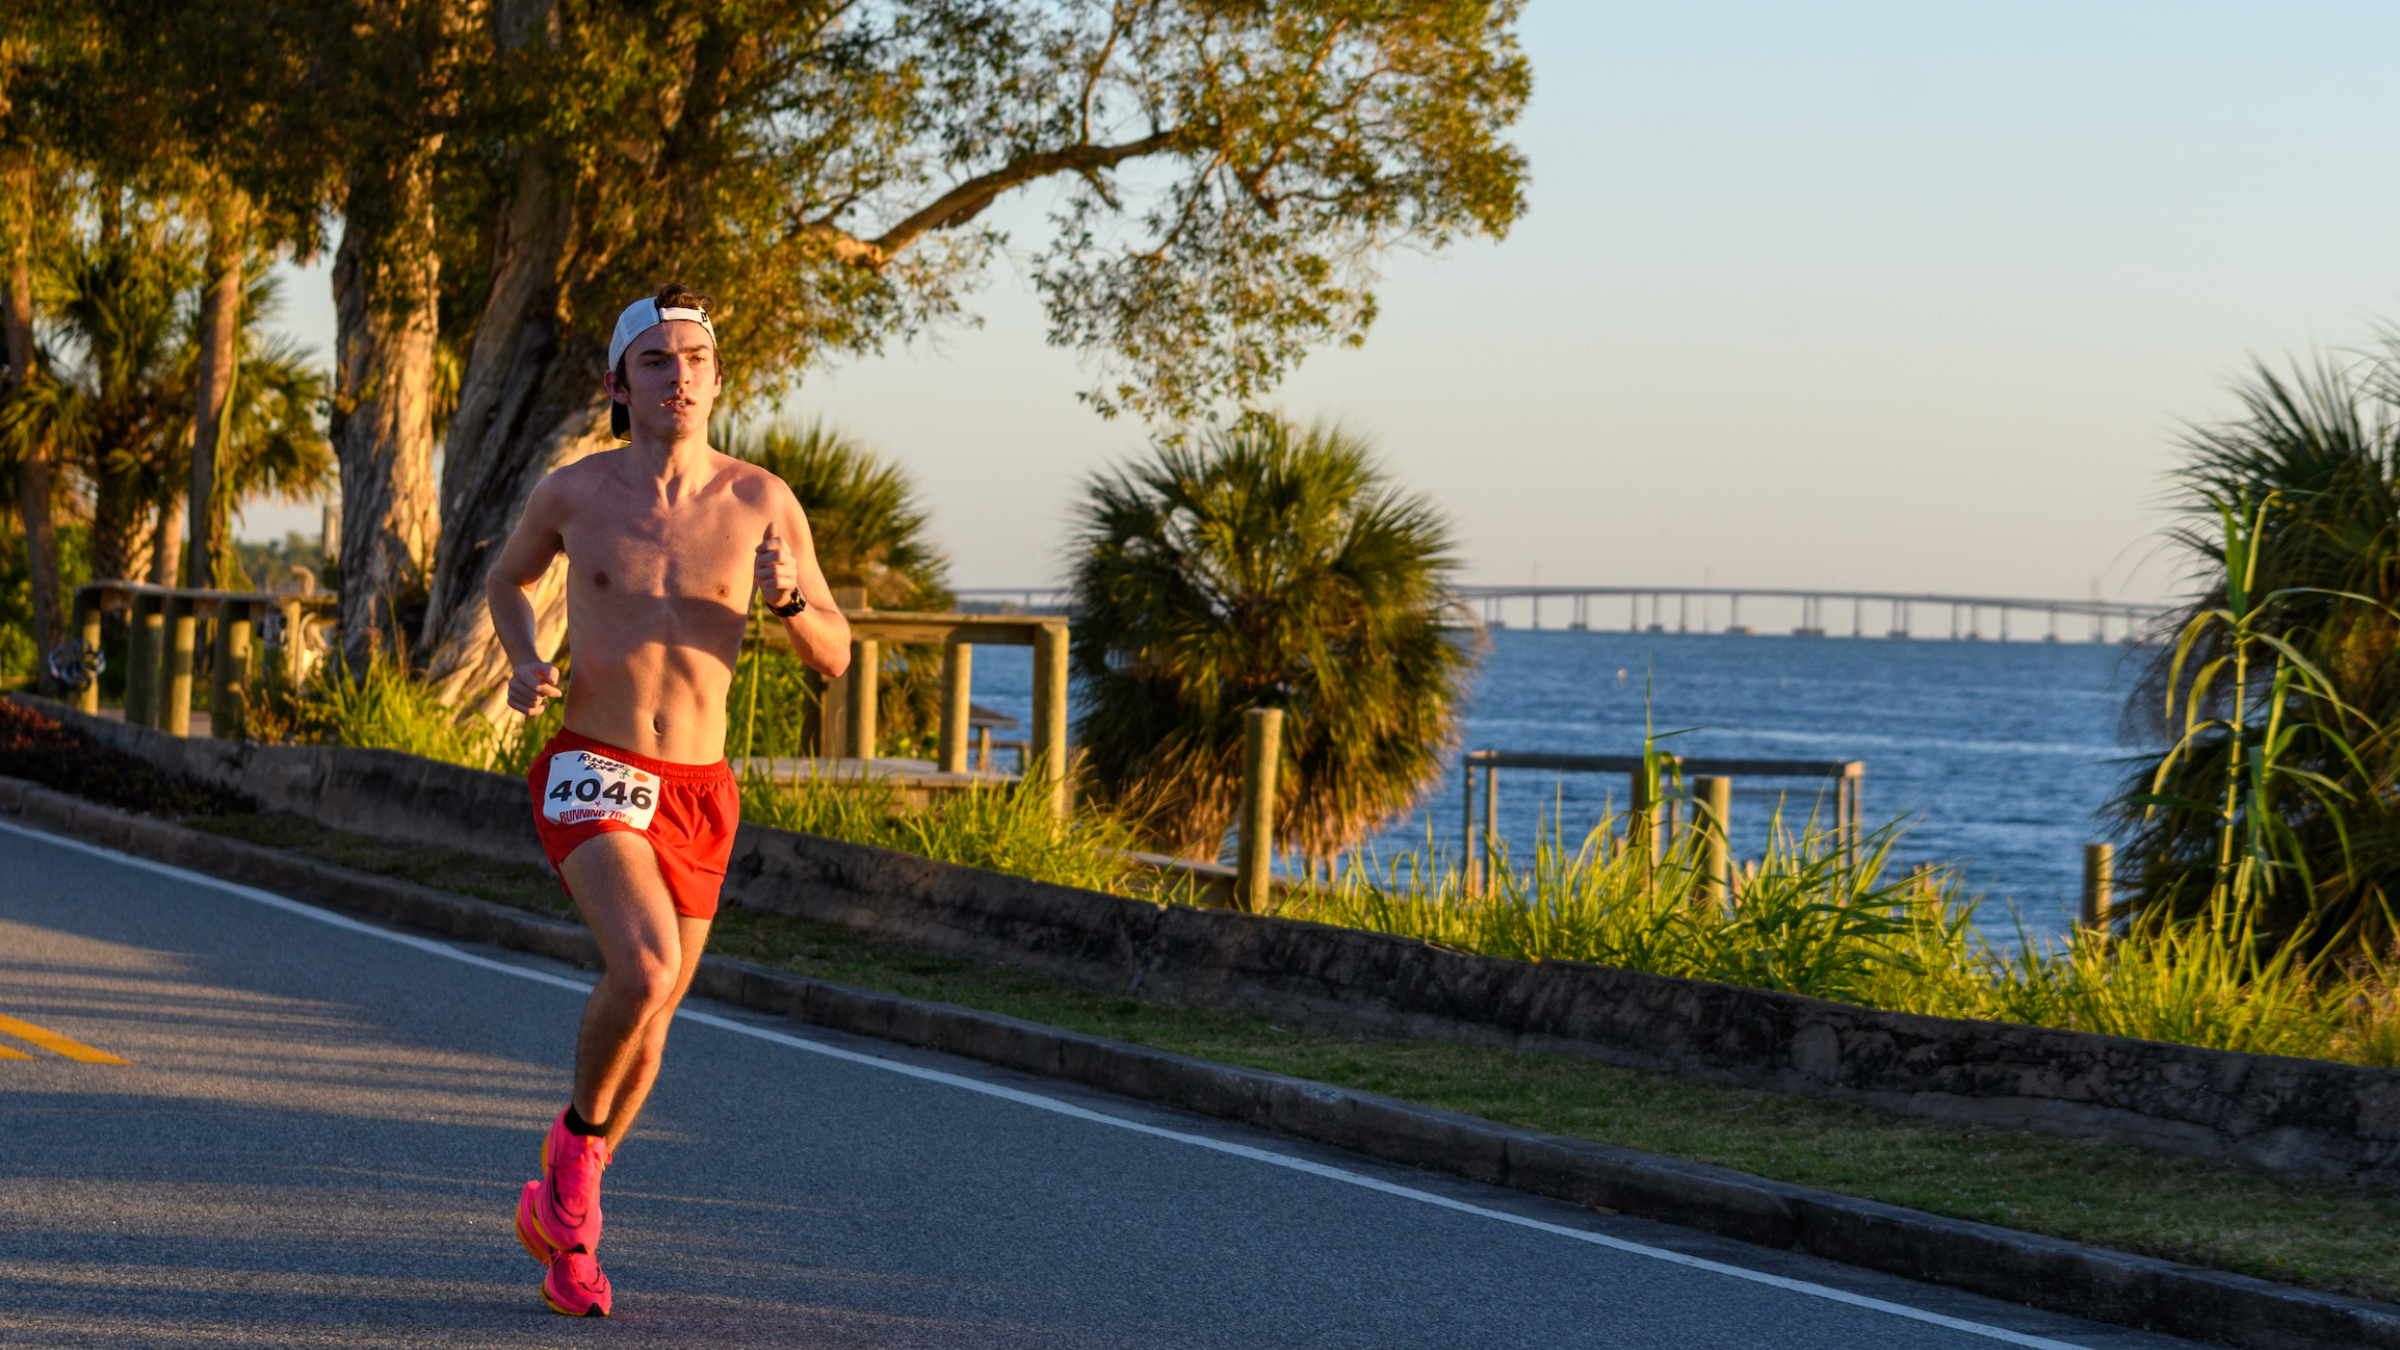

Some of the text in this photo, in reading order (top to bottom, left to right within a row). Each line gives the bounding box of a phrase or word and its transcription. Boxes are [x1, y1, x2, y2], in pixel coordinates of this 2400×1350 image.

[549, 778, 653, 811] 4046
[559, 809, 635, 825] RUNNING ZONE
